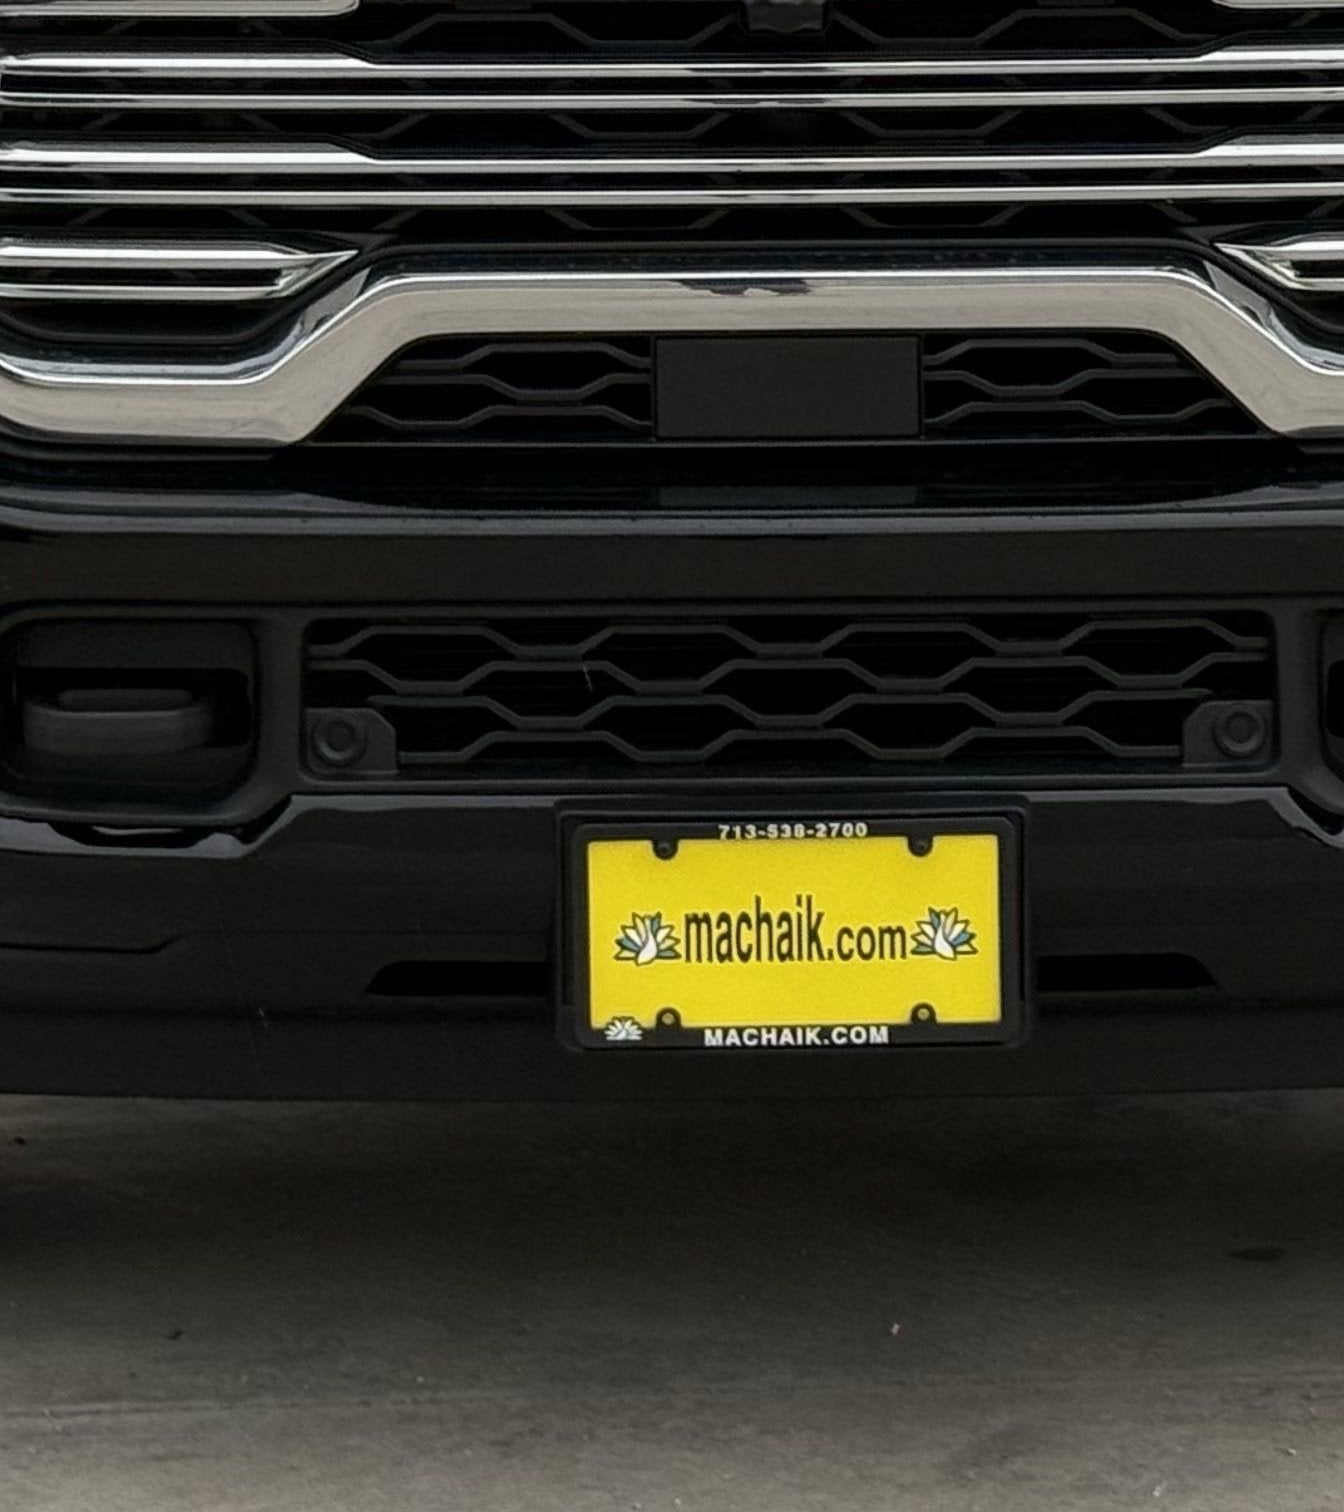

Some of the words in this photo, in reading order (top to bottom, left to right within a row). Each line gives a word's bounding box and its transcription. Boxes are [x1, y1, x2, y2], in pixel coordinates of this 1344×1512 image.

[718, 822, 869, 839] 713-538-2700
[683, 894, 908, 964] machaik.com
[703, 1025, 890, 1047] MACHAIK.COM
